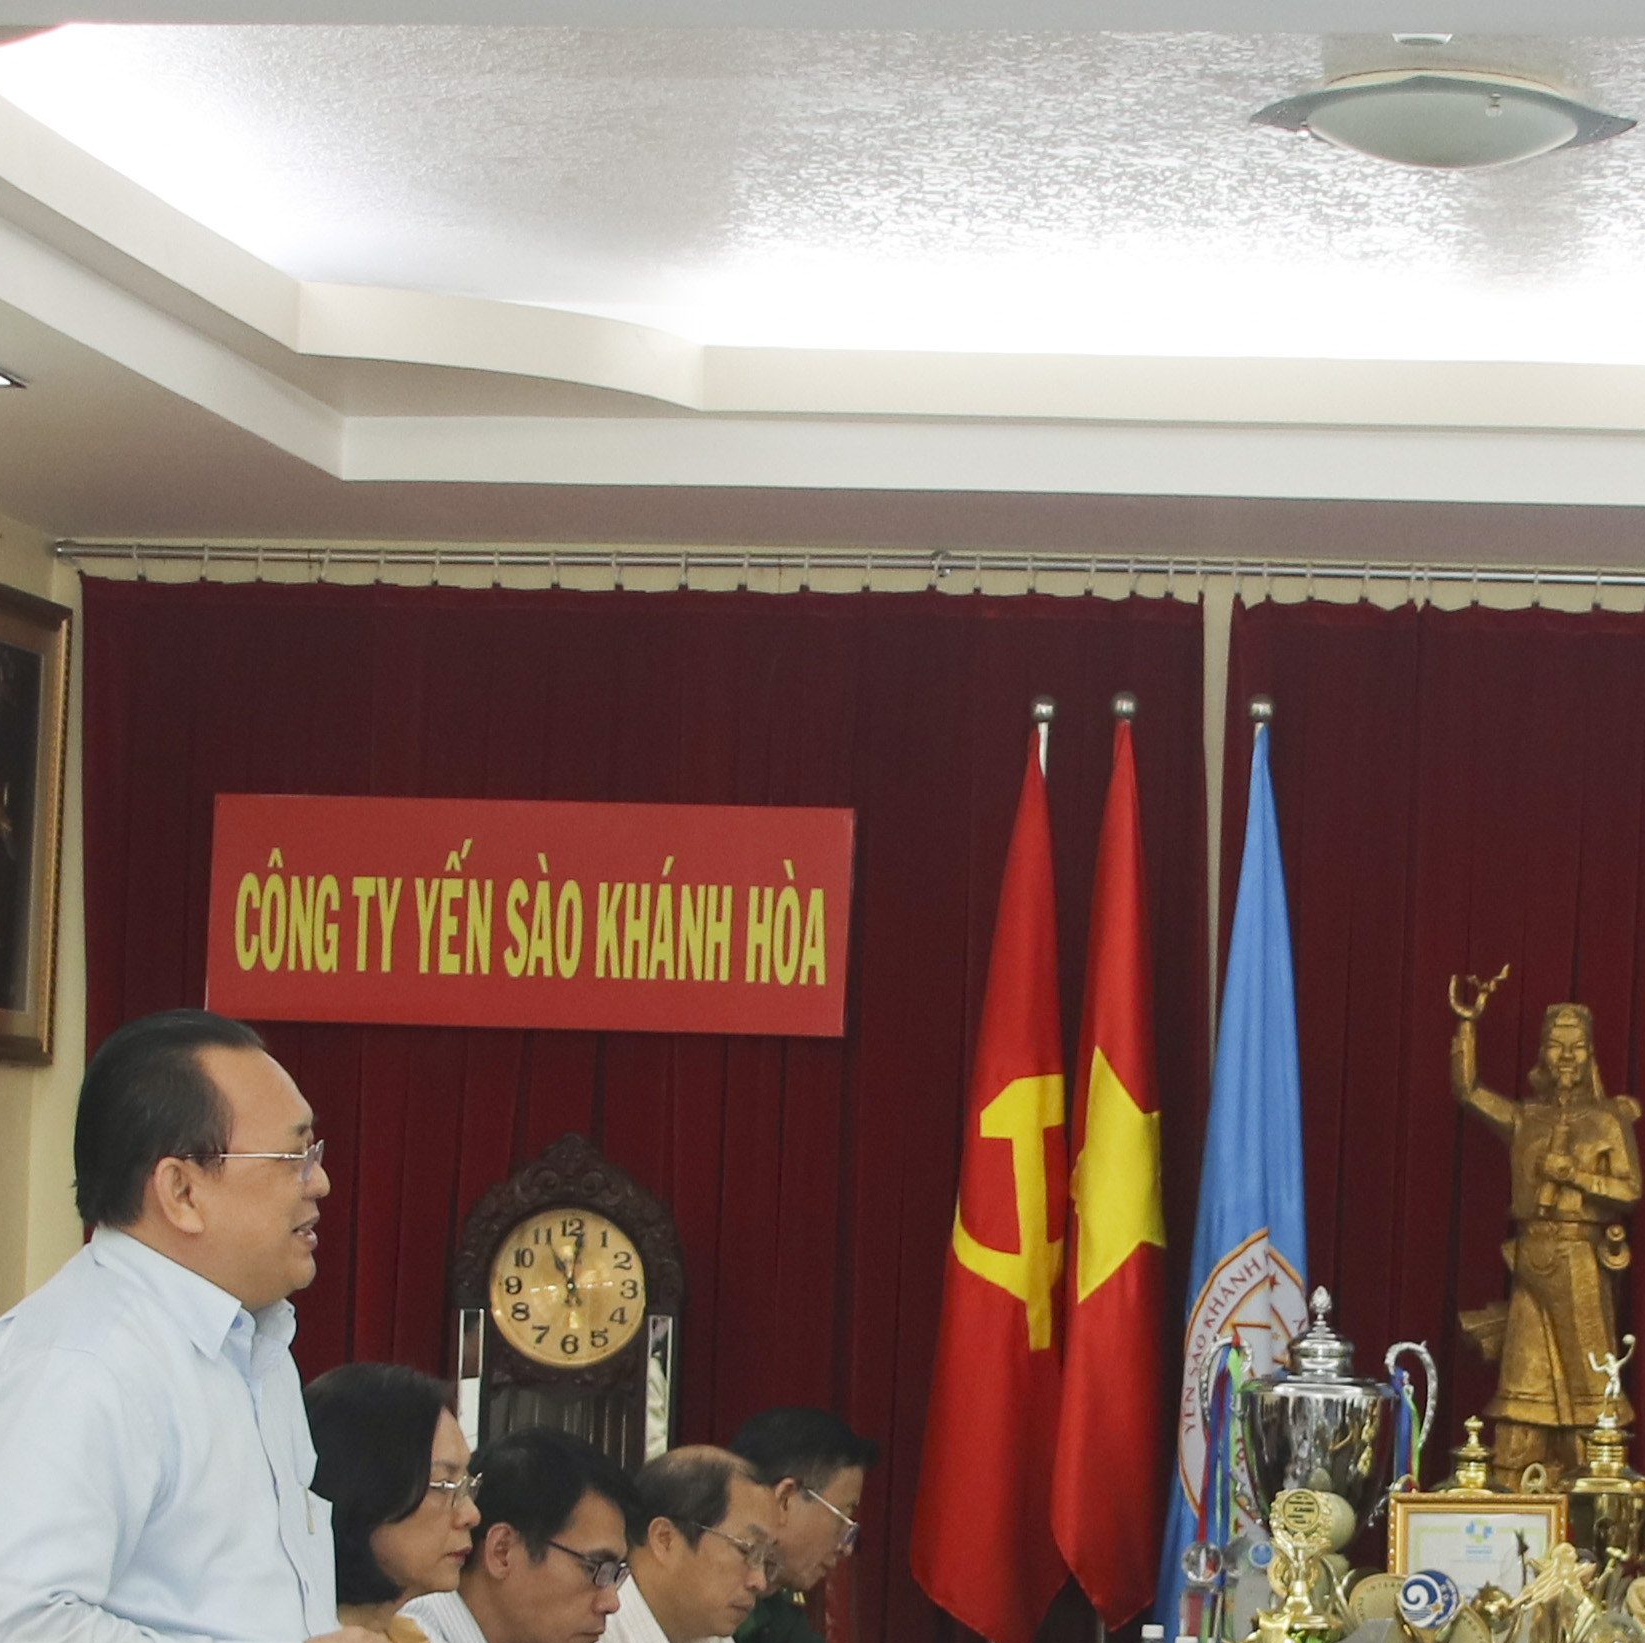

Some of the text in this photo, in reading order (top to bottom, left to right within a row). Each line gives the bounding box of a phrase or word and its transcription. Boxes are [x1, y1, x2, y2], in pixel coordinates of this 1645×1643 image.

[234, 838, 826, 986] CÔNG TY YẾN SÀO KHÁNH HÒA
[534, 1228, 553, 1246] 11
[561, 1218, 585, 1237] 12
[600, 1231, 608, 1248] 1
[514, 1248, 534, 1268] 10
[613, 1251, 632, 1271] 2
[505, 1276, 522, 1295] 9
[621, 1279, 638, 1299] 3
[511, 1301, 530, 1321] 8
[609, 1307, 628, 1325] 4
[531, 1325, 550, 1344] 7
[591, 1330, 609, 1348] 5
[561, 1335, 579, 1354] 6
